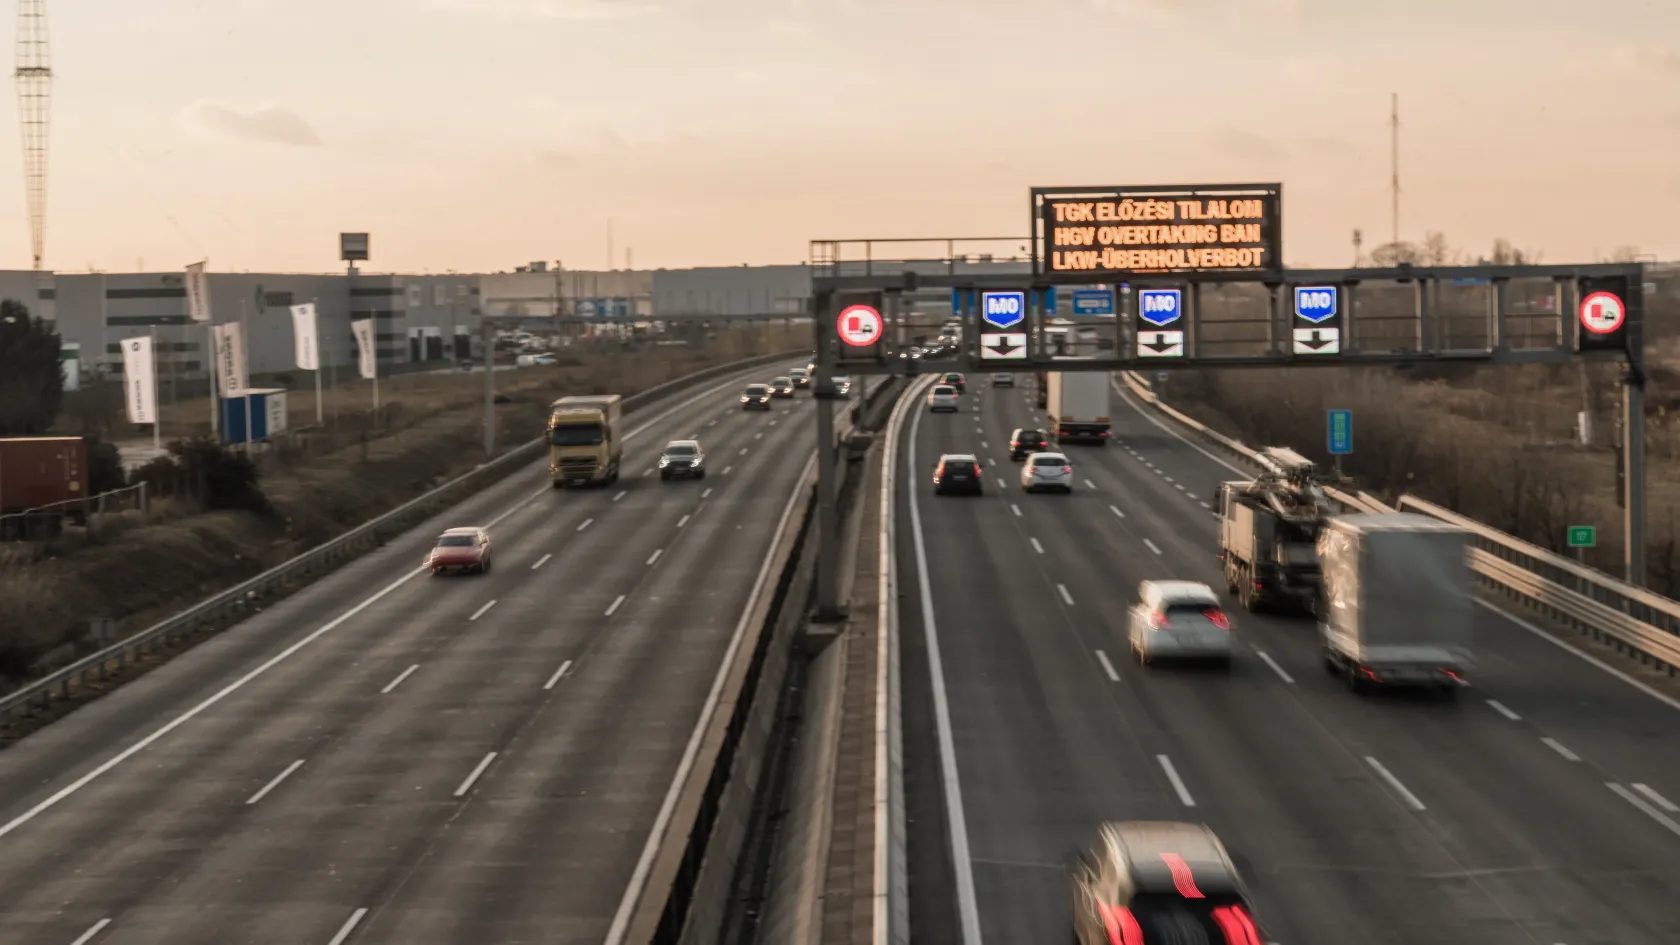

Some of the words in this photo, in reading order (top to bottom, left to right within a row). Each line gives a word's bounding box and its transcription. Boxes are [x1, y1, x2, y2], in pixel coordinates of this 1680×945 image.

[1052, 203, 1095, 222] TGK
[1096, 198, 1175, 221] ELŐZÉSI
[1176, 200, 1263, 219] TILALOM
[1054, 226, 1095, 246] HGV
[1097, 224, 1218, 245] OVERTAKING
[1220, 223, 1261, 243] BAN
[1052, 247, 1265, 270] LKW-ÜBERHOLVERBOT
